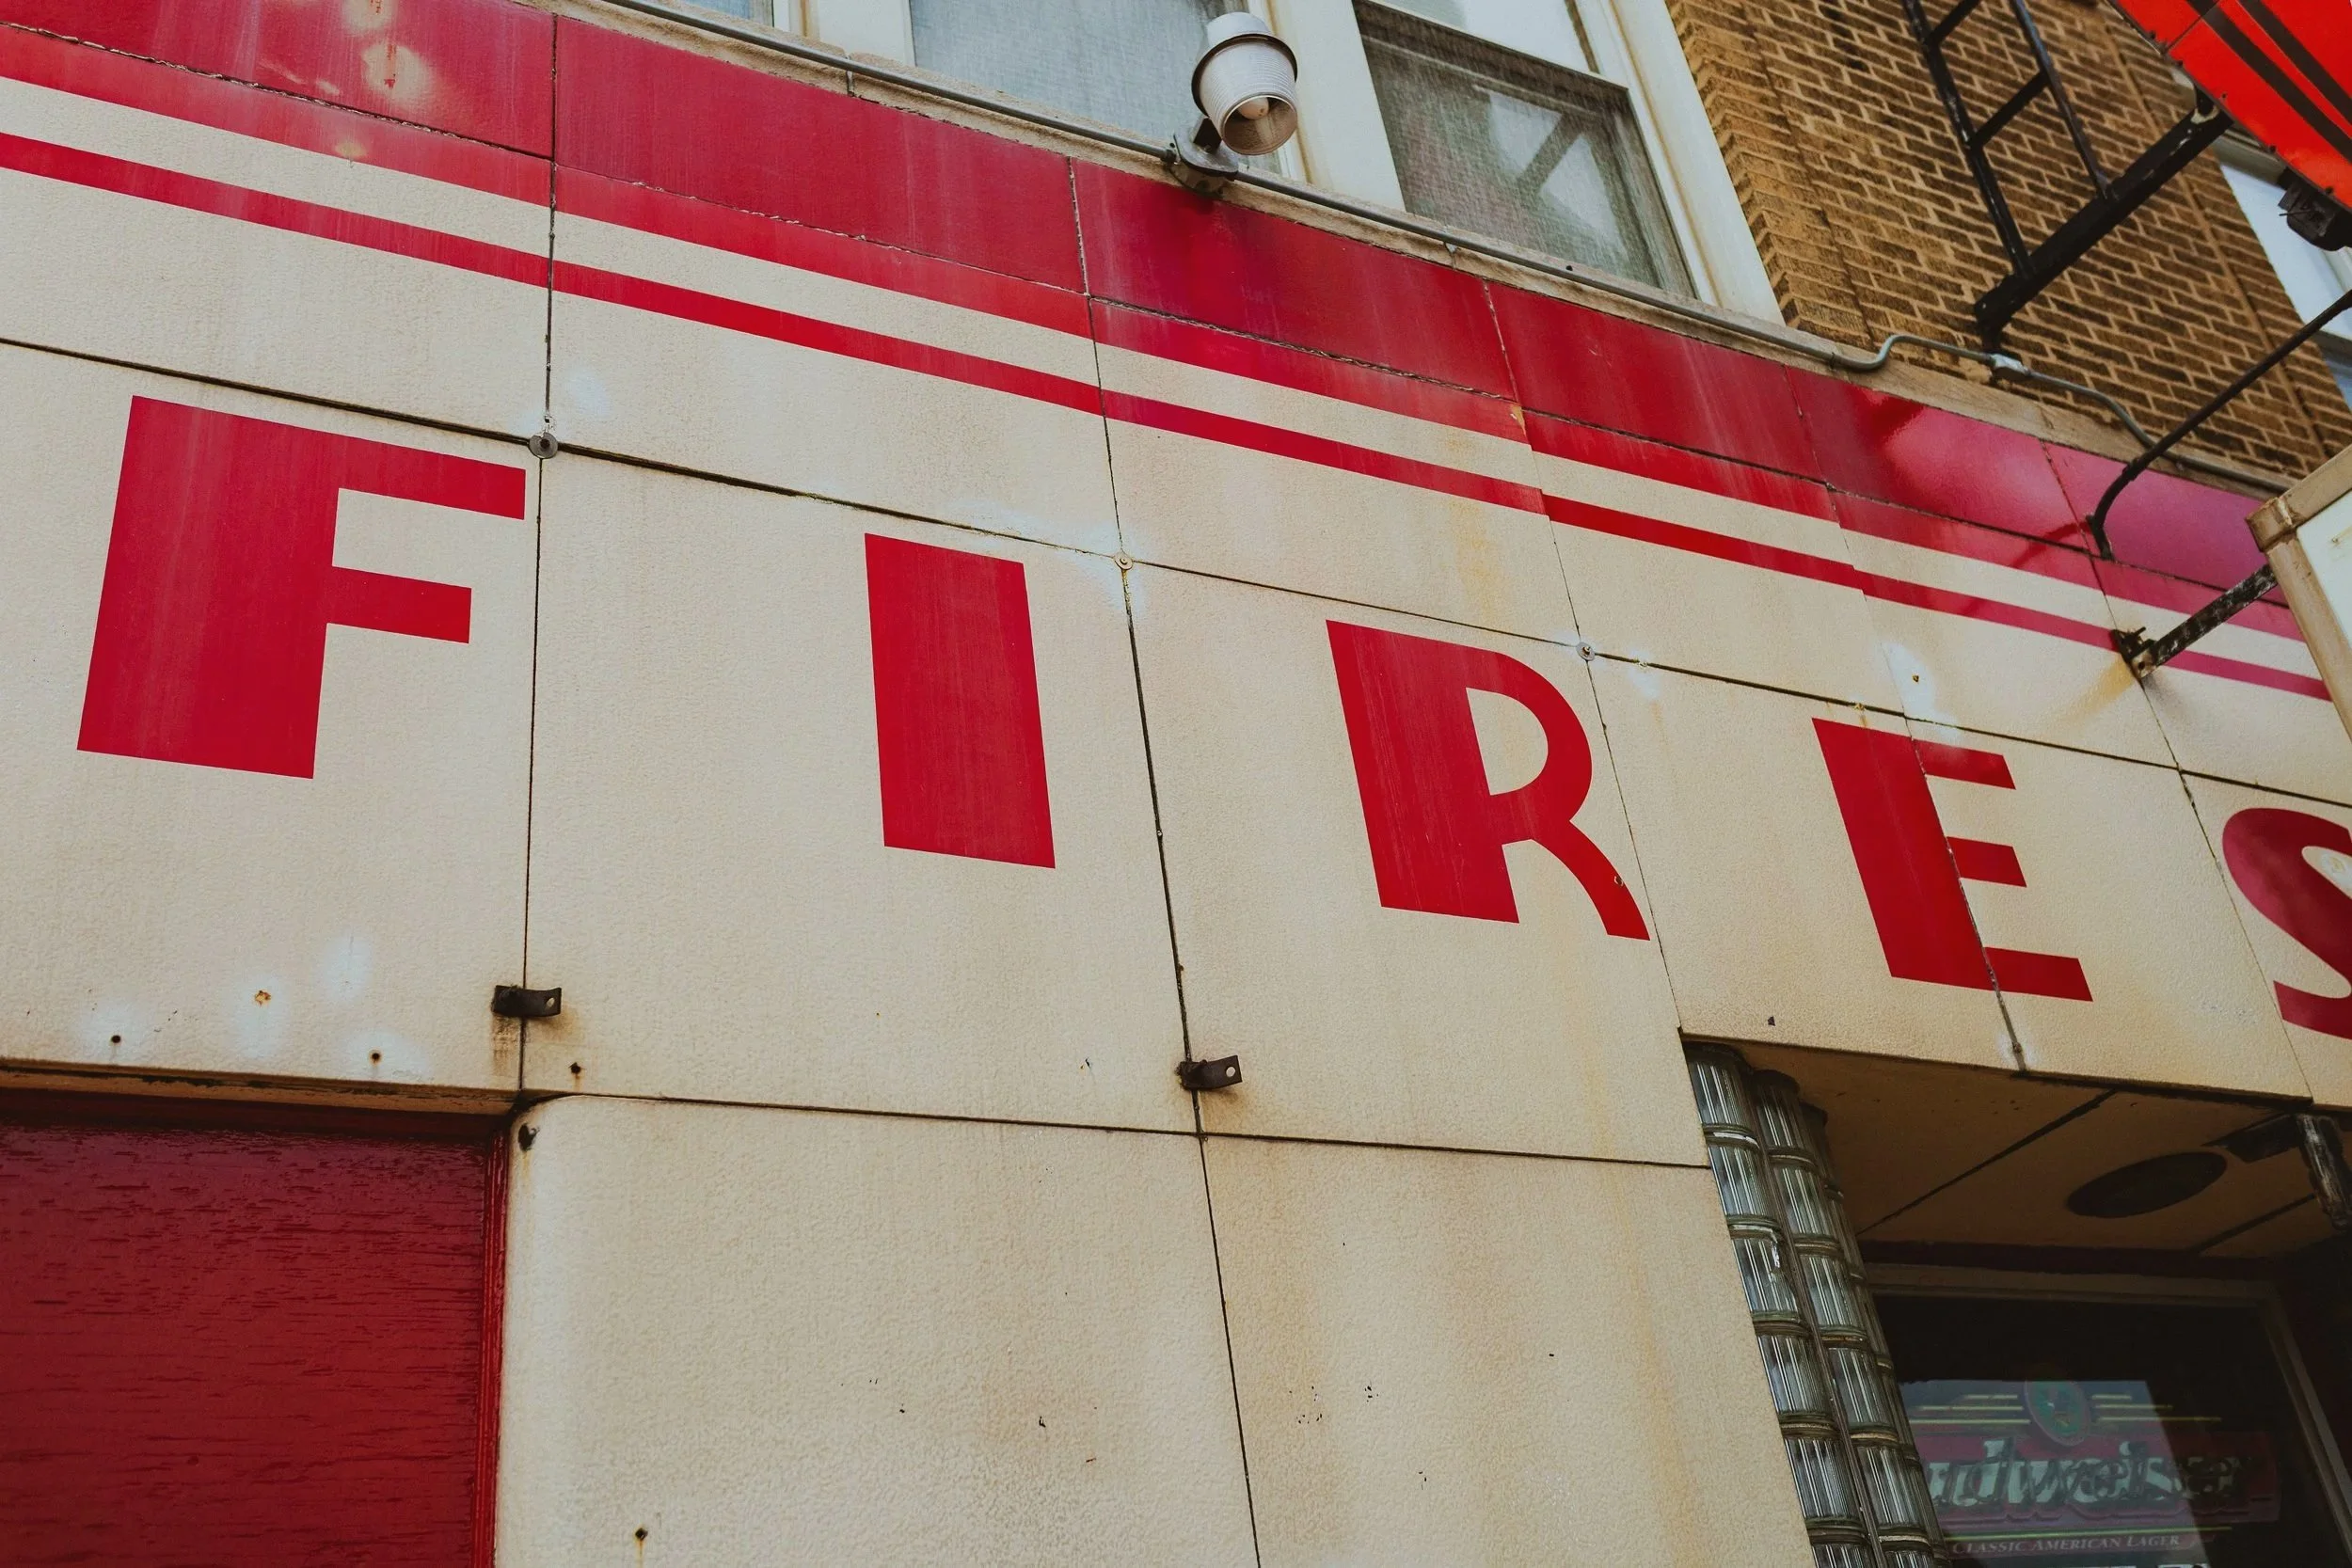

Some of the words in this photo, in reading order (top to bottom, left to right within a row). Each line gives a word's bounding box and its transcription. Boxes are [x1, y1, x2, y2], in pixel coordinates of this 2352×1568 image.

[1952, 1540, 2028, 1555] CLASSIC
[2031, 1535, 2121, 1553] AMERICAN
[2126, 1532, 2182, 1548] LAGER
